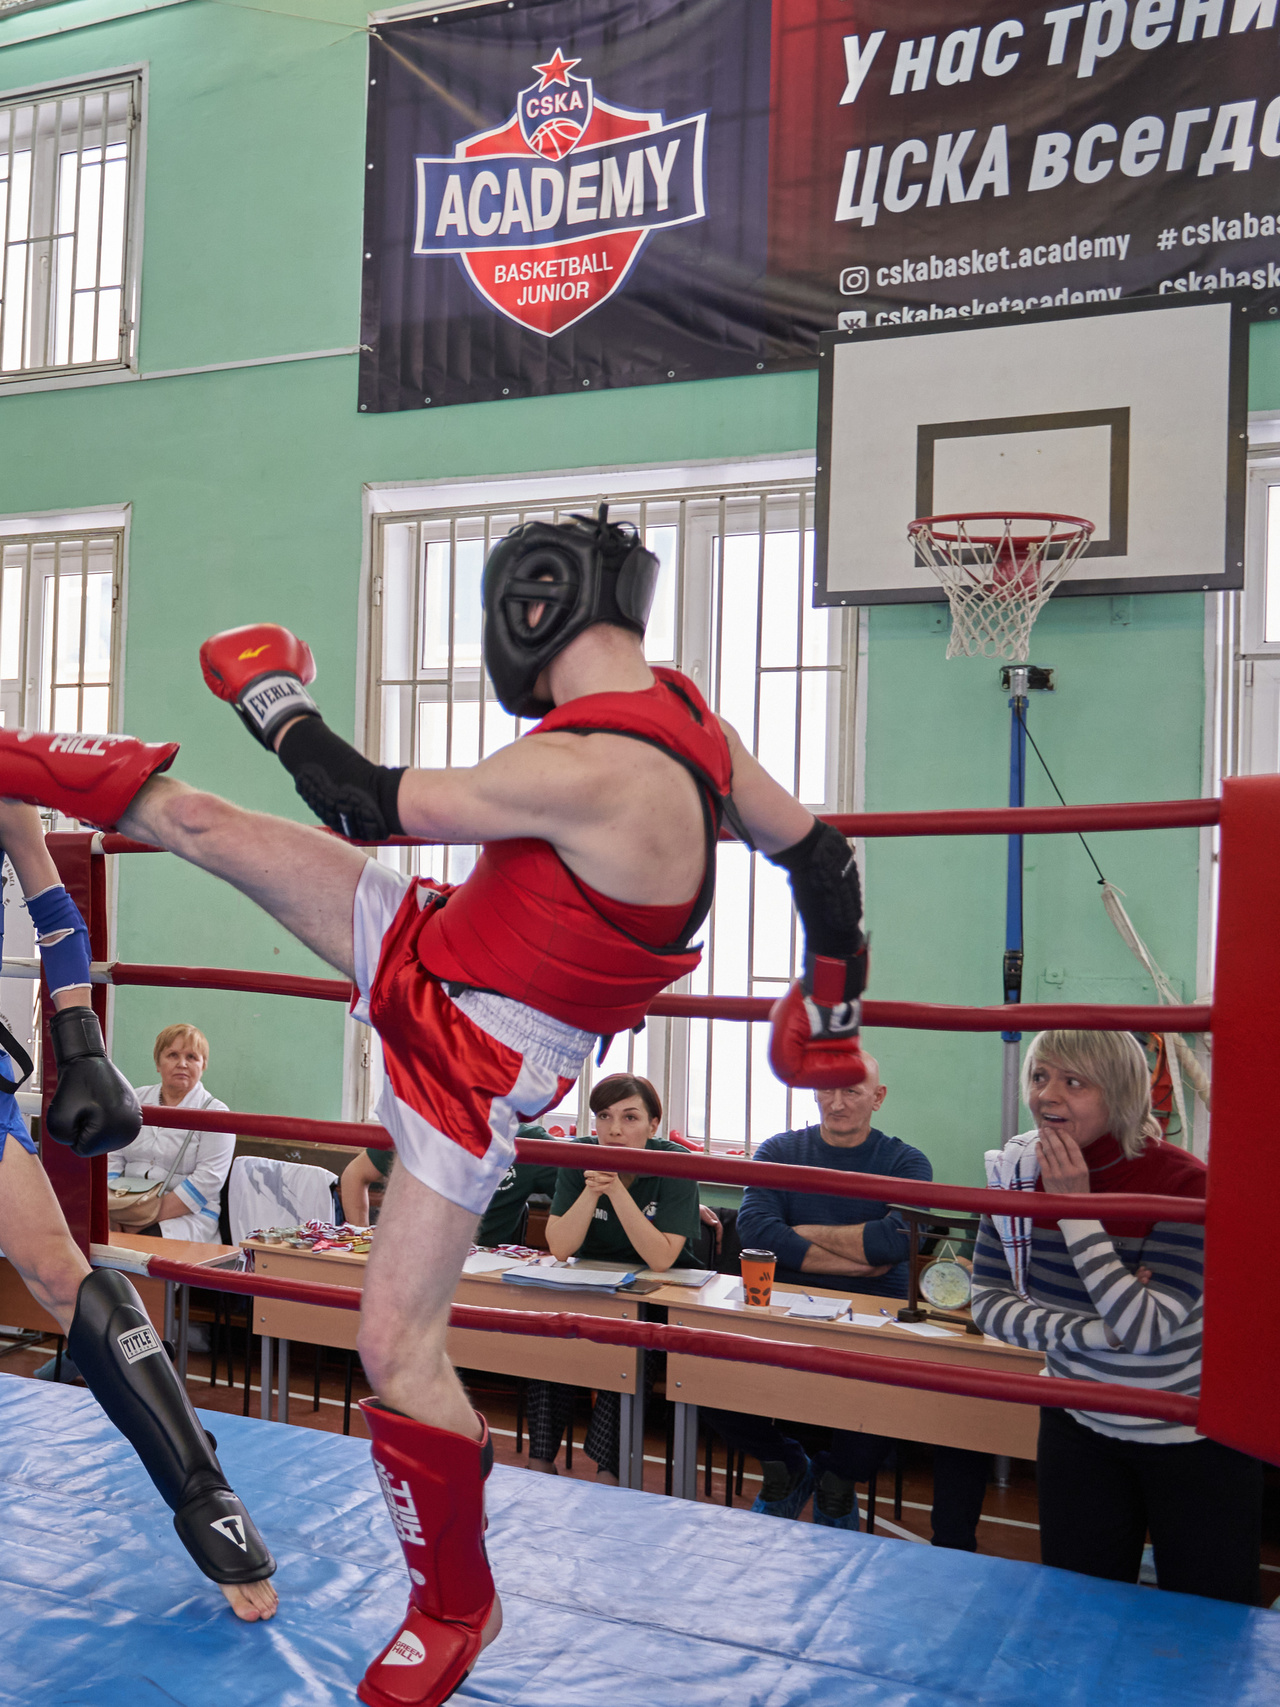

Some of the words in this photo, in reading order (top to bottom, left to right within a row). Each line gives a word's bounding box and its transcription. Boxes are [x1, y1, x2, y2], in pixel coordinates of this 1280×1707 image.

[839, 30, 886, 106] У
[889, 20, 1024, 96] нас
[526, 90, 584, 119] CSKA
[435, 139, 681, 237] ACADEMY
[834, 125, 1010, 227] ЦСКА
[494, 252, 614, 284] BASKETBALL
[876, 233, 1131, 287] cskabasket.academy
[517, 281, 590, 306] JUNIOR
[122, 1331, 152, 1353] TITLE
[391, 1480, 426, 1546] HILL
[392, 1645, 413, 1663] HILL
[395, 1640, 423, 1659] GREEN
